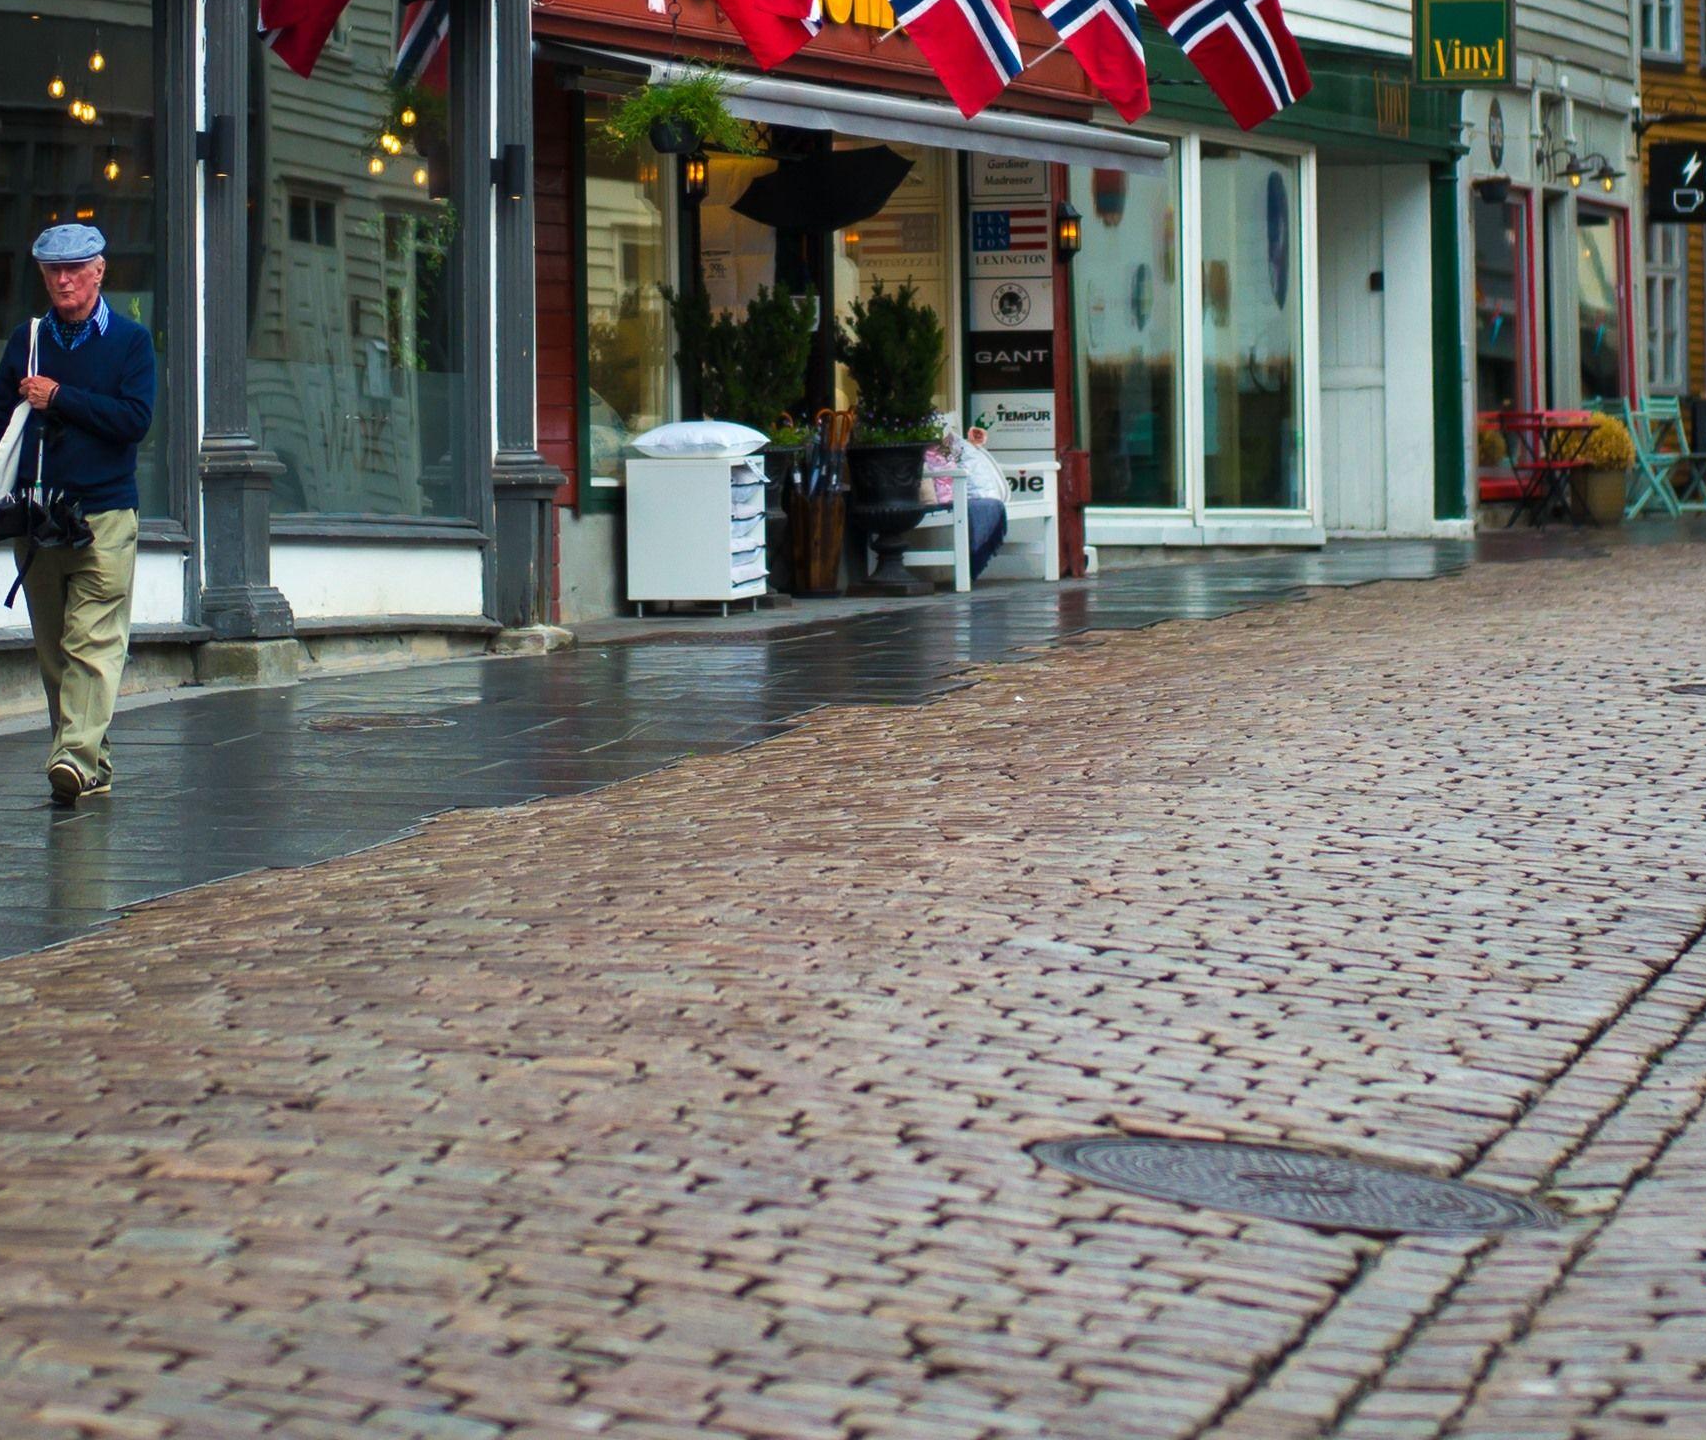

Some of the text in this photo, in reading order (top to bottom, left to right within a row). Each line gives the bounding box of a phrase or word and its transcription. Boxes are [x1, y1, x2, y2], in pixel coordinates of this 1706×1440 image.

[1433, 37, 1505, 78] Vinyl
[975, 253, 1046, 266] LEXINGTON
[974, 349, 1049, 364] GANT
[996, 410, 1051, 422] TEMPUR
